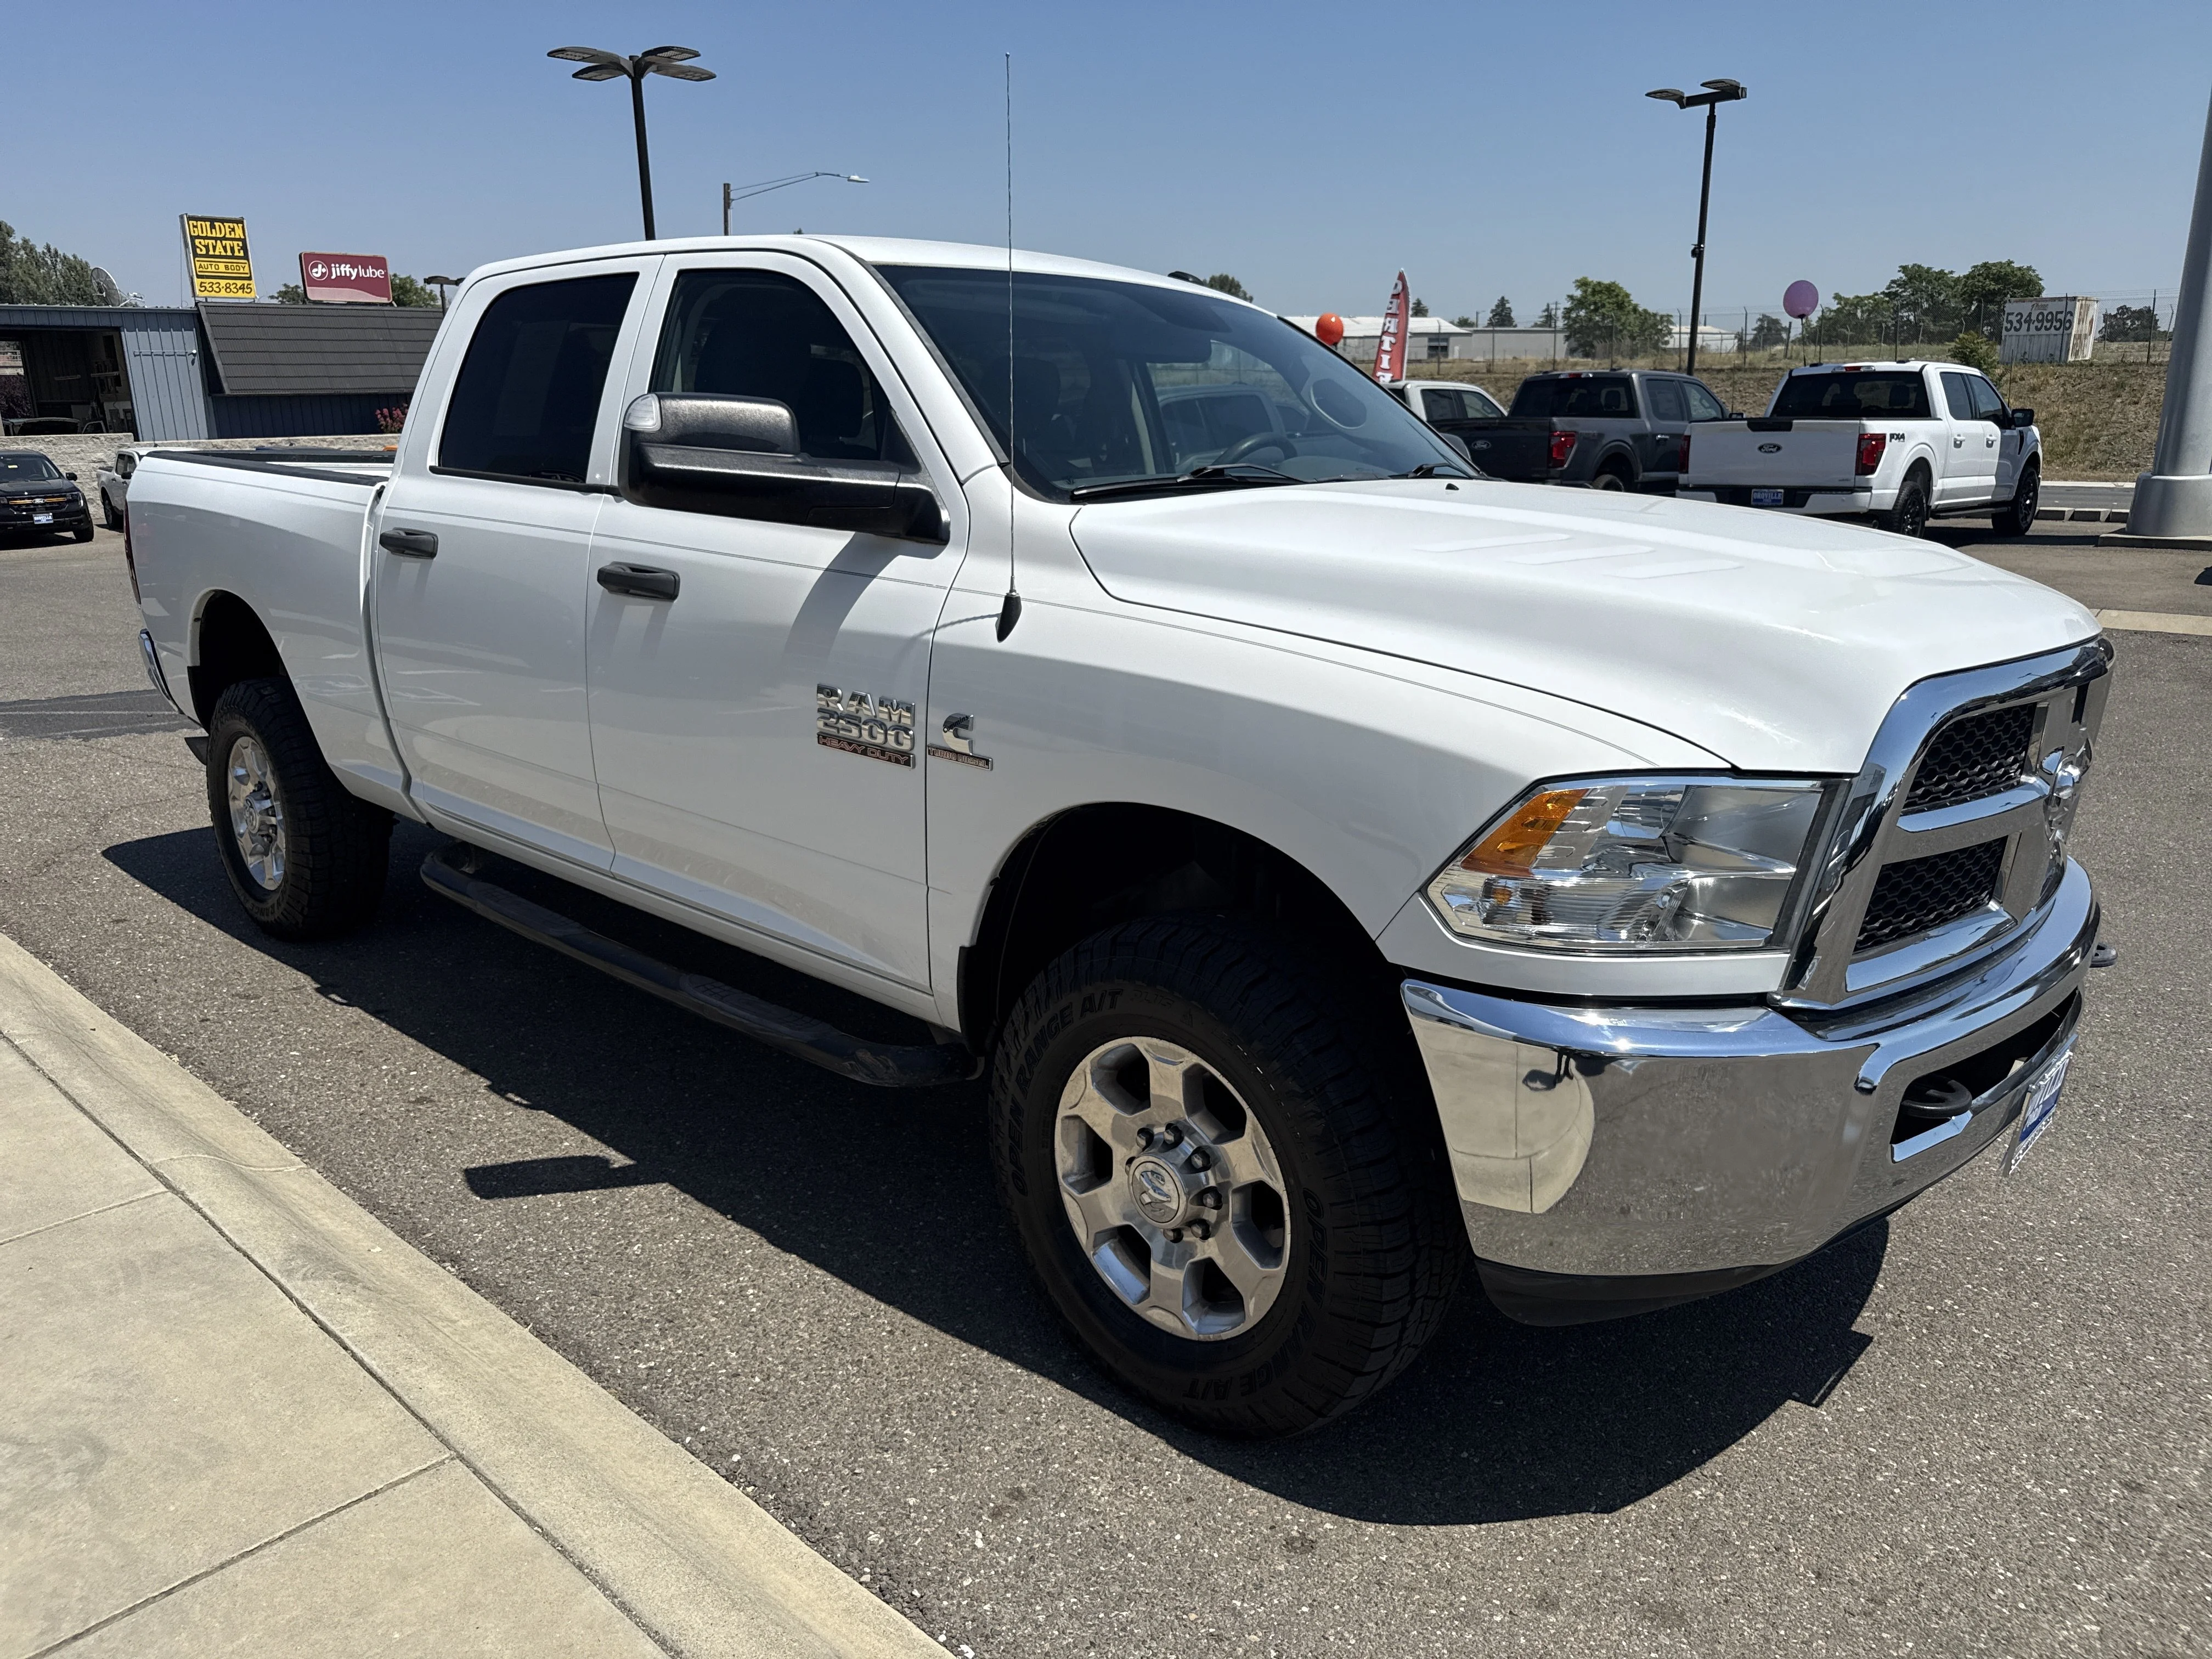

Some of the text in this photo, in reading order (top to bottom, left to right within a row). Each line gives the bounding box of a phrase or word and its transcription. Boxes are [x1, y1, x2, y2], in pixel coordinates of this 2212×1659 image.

[189, 221, 245, 239] GOLDEN
[195, 239, 244, 256] STATE
[331, 263, 385, 280] jiffy lube
[817, 683, 915, 727] RAM
[817, 707, 915, 752] 2500
[819, 736, 909, 764] HEAVY DUTY
[928, 747, 989, 768] TURBO DIESEL
[1080, 989, 1124, 1018] A/T
[1016, 1002, 1074, 1099] RANGE
[1008, 1094, 1029, 1197] OPEN
[1182, 1187, 1328, 1401] OPEN RANGE A/T
